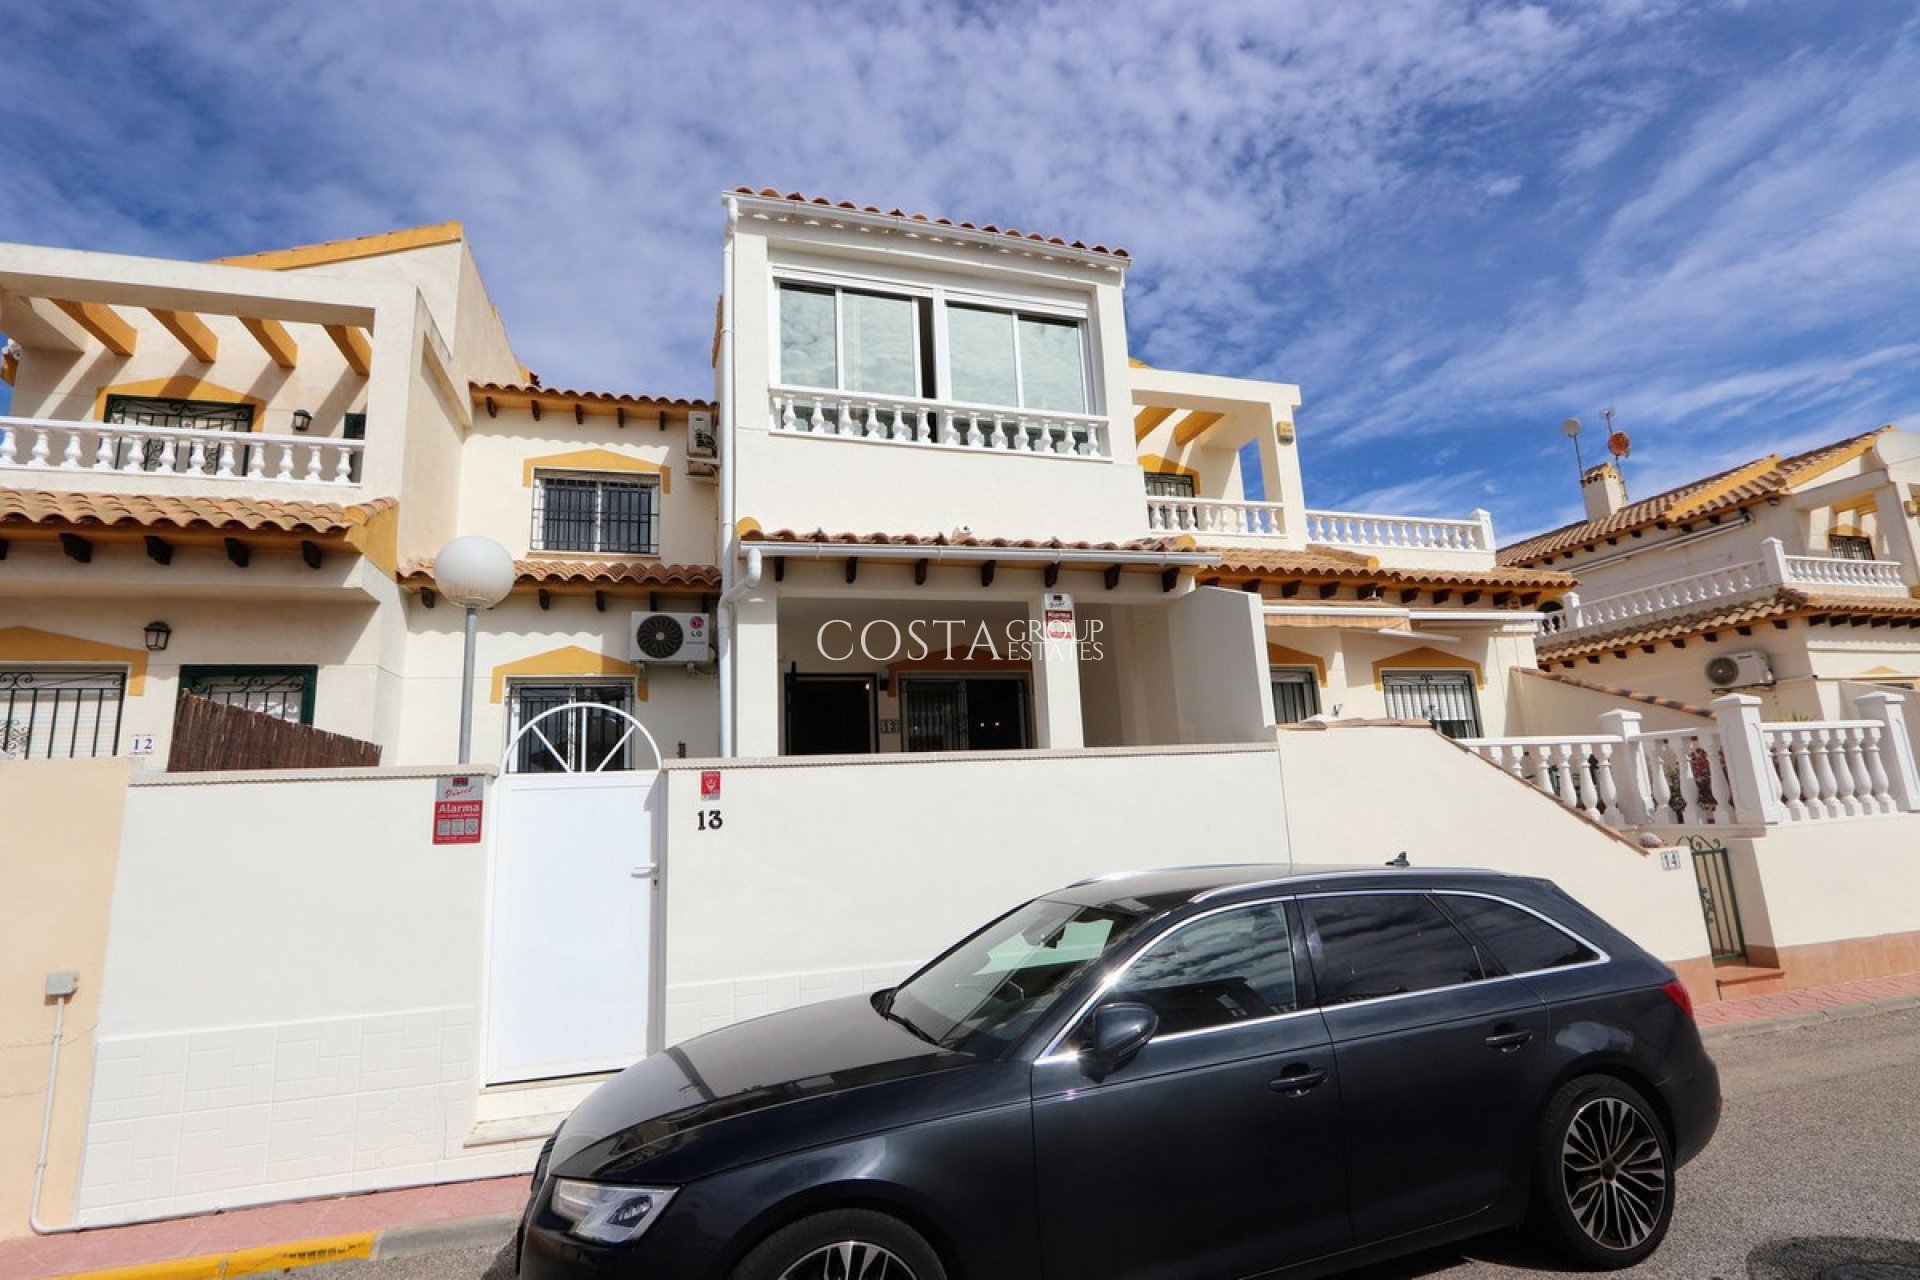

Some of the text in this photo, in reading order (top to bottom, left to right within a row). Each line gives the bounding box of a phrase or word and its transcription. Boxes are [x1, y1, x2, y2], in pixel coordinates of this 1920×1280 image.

[134, 738, 153, 750] 12
[438, 803, 480, 813] Alarma
[697, 809, 723, 831] 13
